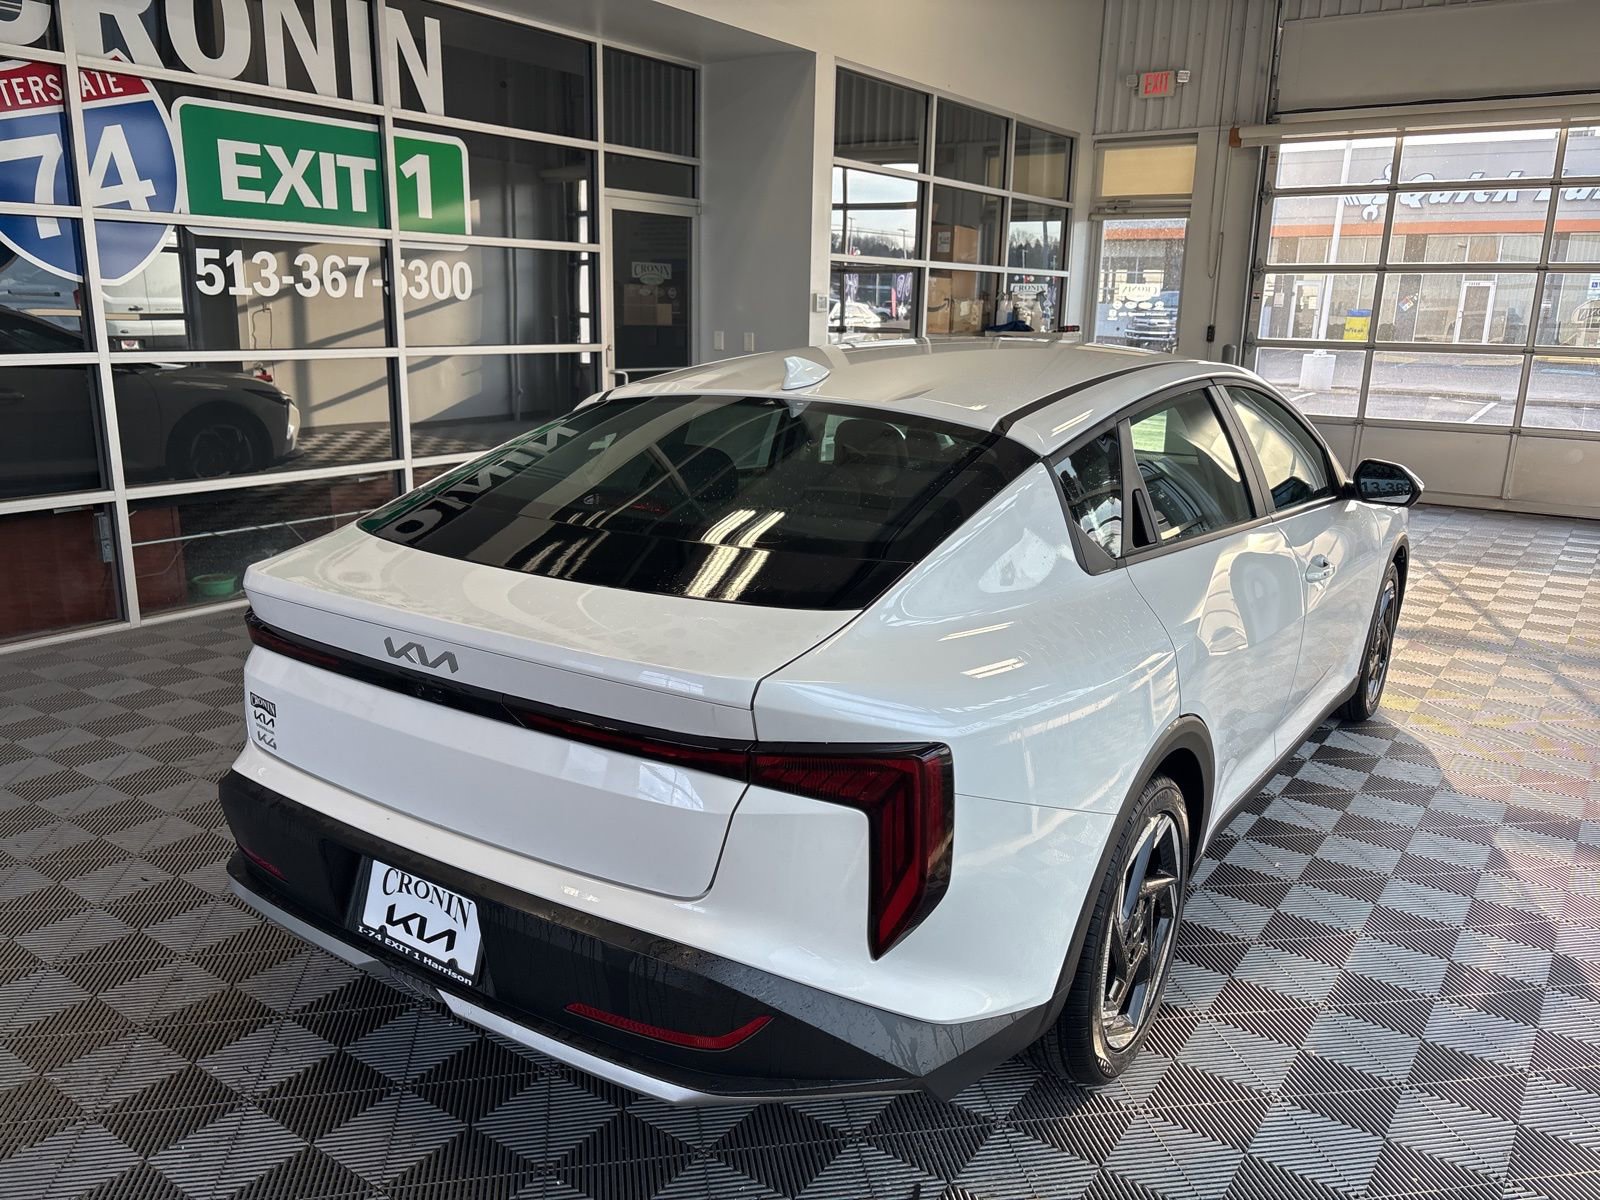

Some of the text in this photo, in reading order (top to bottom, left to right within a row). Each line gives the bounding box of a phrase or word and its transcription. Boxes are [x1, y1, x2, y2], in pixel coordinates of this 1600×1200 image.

[1144, 72, 1168, 95] EXIT
[0, 124, 157, 240] 74
[217, 139, 433, 219] EXIT 1
[633, 263, 671, 278] CRONIN
[384, 636, 459, 674] KIA
[253, 709, 275, 728] KIA
[257, 731, 277, 750] K4
[382, 867, 473, 932] CRONIN
[385, 903, 457, 952] KIA
[358, 926, 473, 986] I-74 EXIT 1 Harrison
